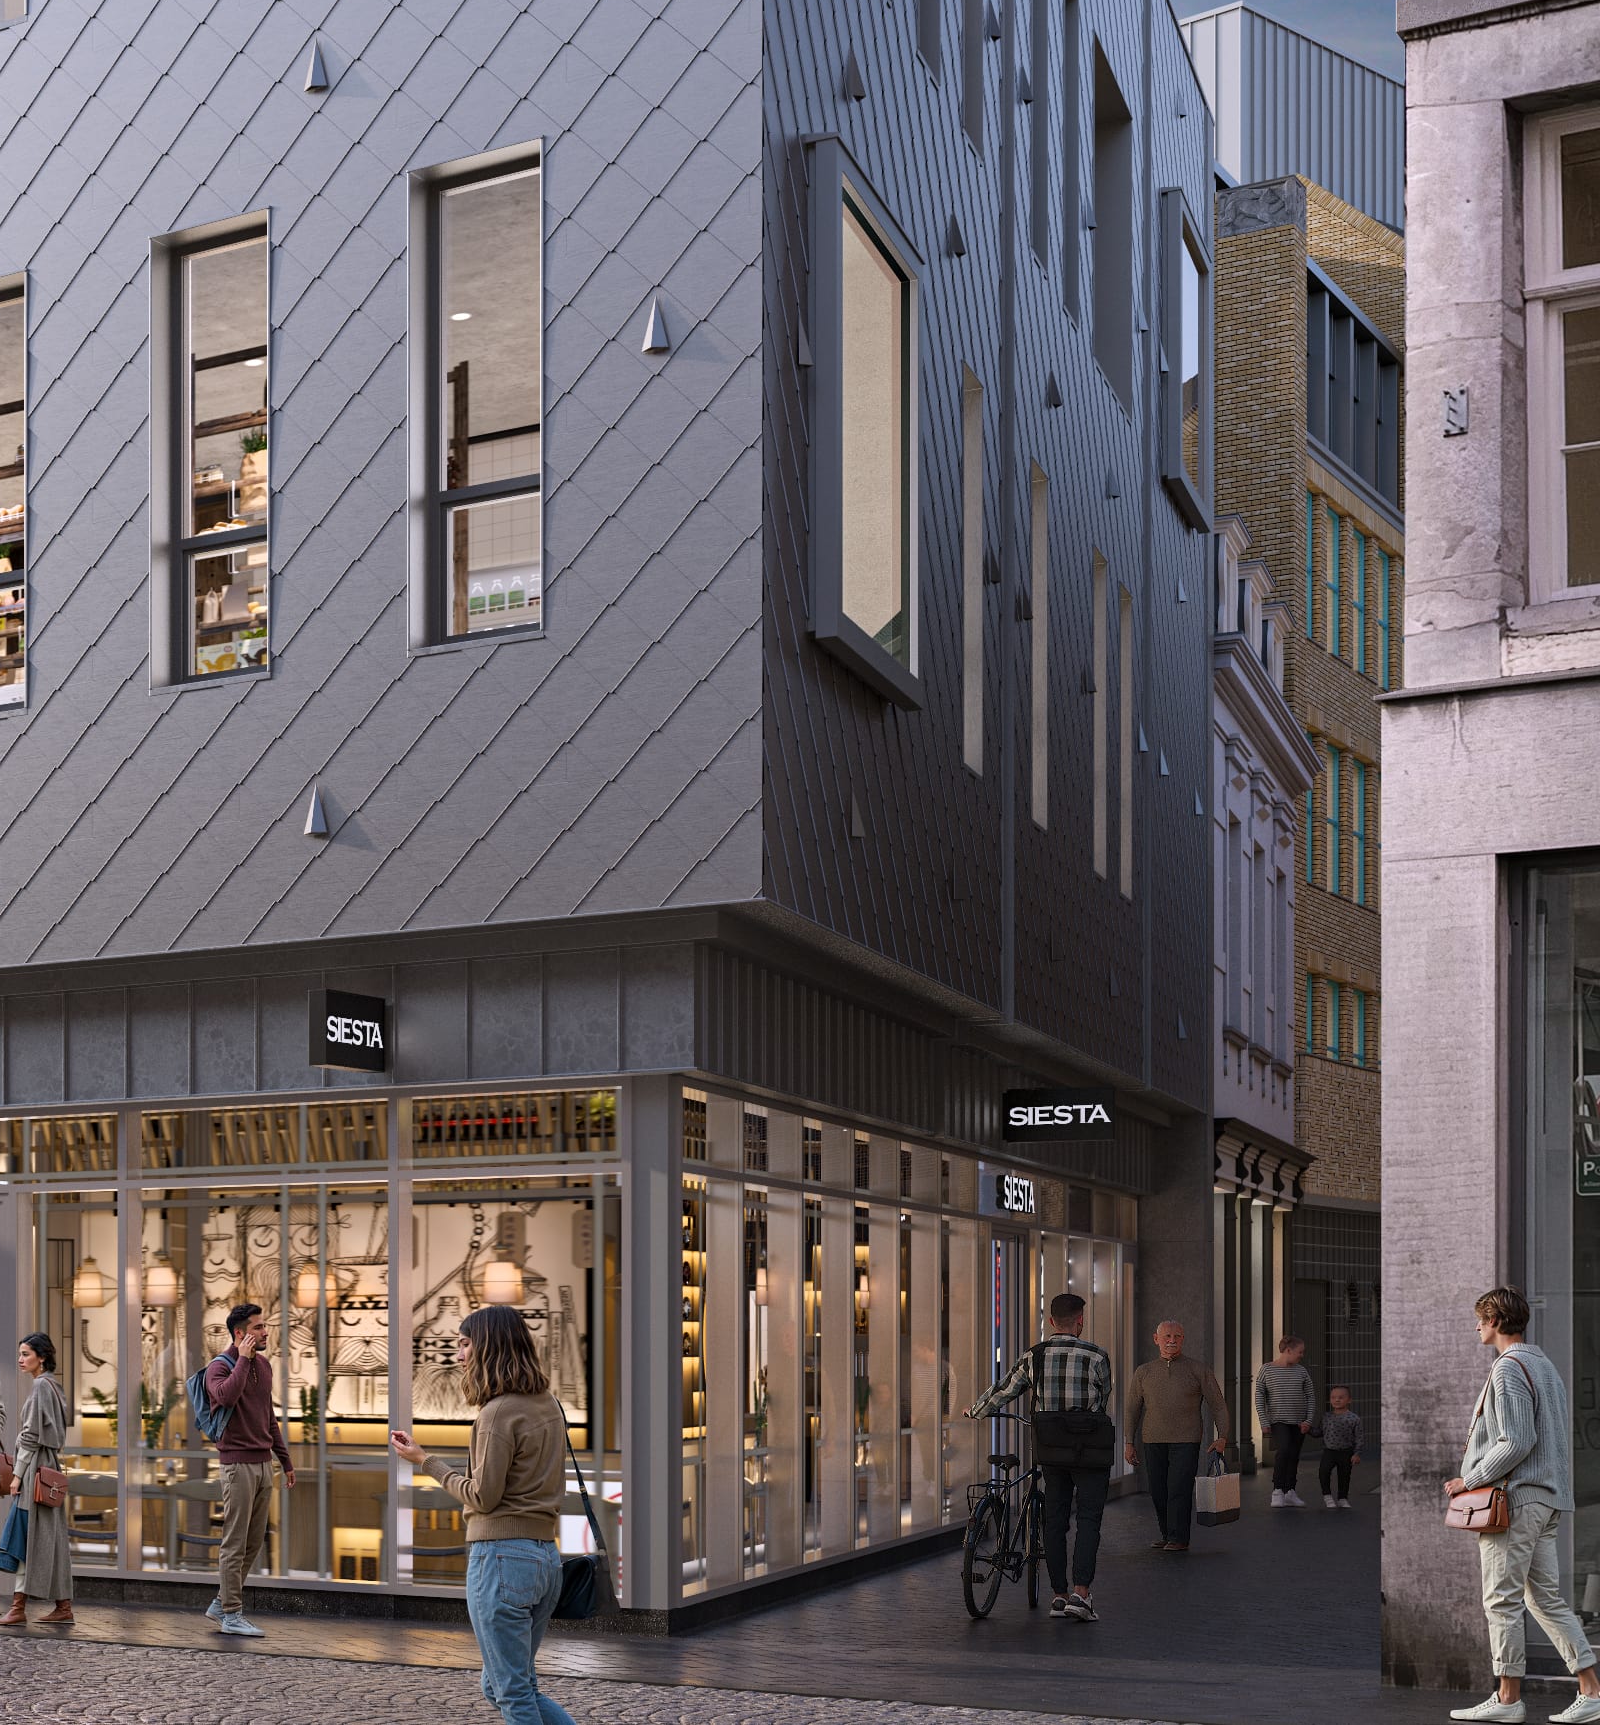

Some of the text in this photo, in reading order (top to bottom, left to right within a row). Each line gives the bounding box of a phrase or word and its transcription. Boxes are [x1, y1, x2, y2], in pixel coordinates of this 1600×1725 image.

[326, 1015, 384, 1050] SIESTA
[1008, 1104, 1112, 1126] SIESTA
[1003, 1174, 1035, 1214] SIESTA
